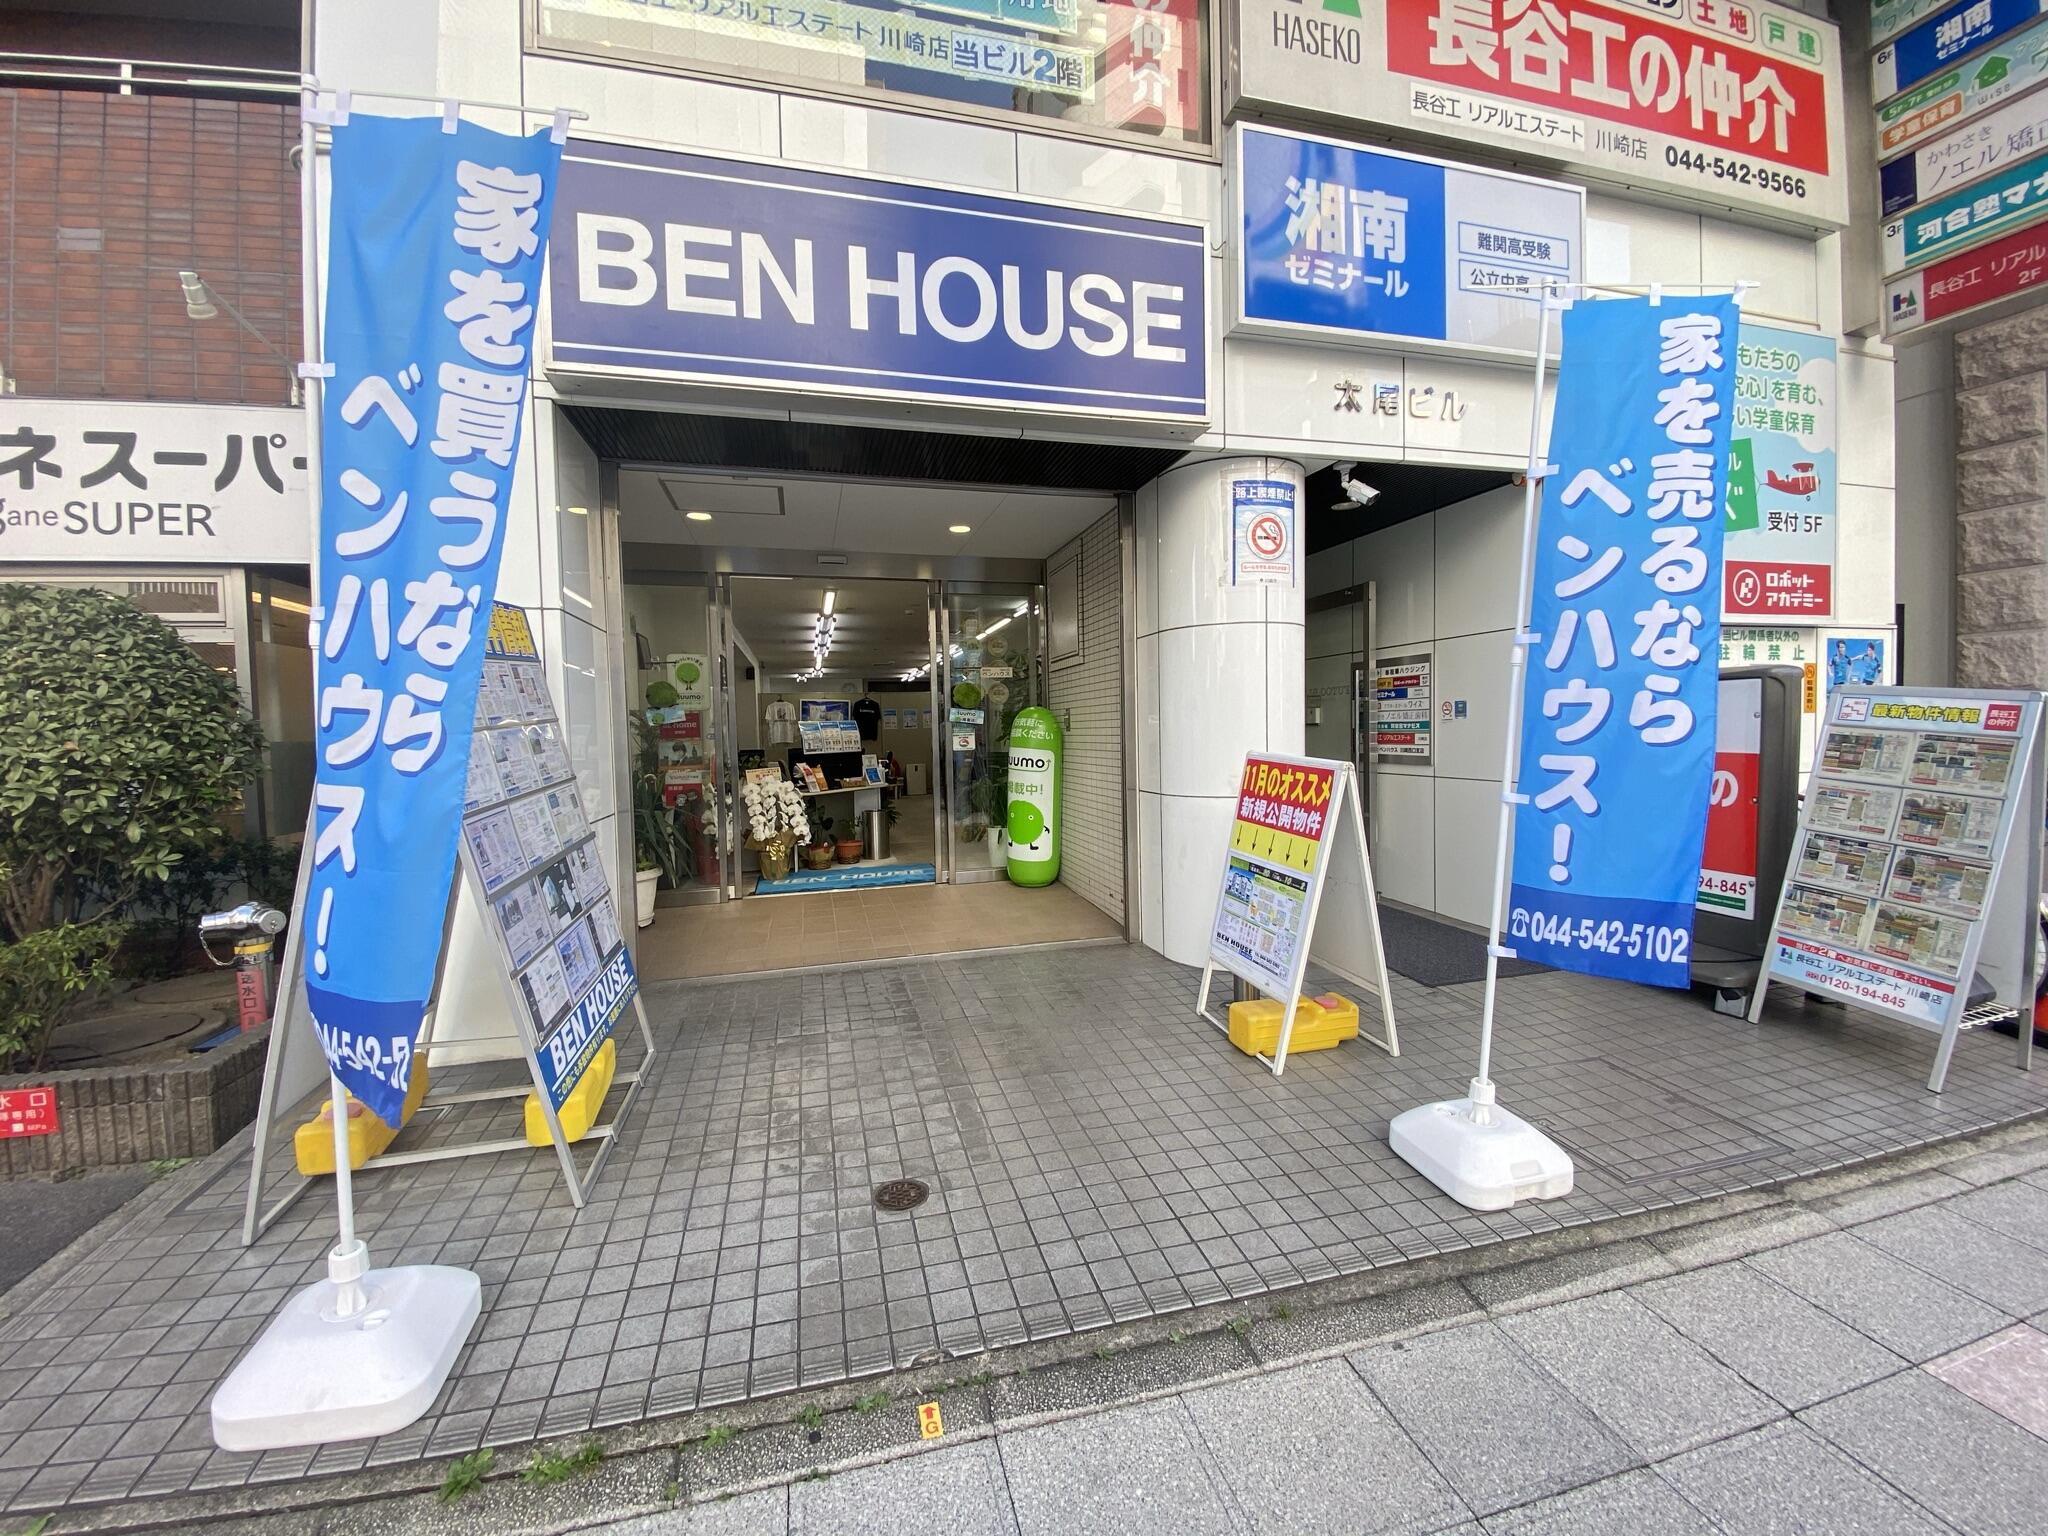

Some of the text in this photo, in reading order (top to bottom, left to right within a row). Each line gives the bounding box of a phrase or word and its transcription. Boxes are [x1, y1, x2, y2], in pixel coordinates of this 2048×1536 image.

[1273, 11, 1361, 64] HASEKO
[1697, 0, 1747, 34] 土地
[1767, 20, 1815, 57] 戸建
[1935, 3, 1992, 48] 湘南
[880, 26, 949, 60] 川崎店
[954, 39, 1081, 87] 当ビル2階
[1877, 51, 1893, 64] 6F
[1936, 24, 1994, 60] ゼミナール
[1428, 0, 1796, 153] 長谷工の仲介
[1412, 91, 1647, 160] 長谷工 リアルエステート 川崎店
[1927, 125, 1992, 165] かわさき
[1665, 145, 1806, 198] 044-542-9566
[1285, 175, 1409, 264] 湘南
[1887, 223, 1903, 238] 3F
[1477, 231, 1552, 261] 難関高受験
[576, 212, 1187, 364] BEN HOUSE
[1285, 254, 1409, 298] ゼミナール
[1929, 244, 2047, 300] 長谷工 リアル
[2018, 267, 2041, 285] 2F
[0, 426, 307, 494] ネスーパ
[381, 160, 543, 773] 家を買うなら
[1629, 312, 1724, 745] 家を売るなら
[1767, 512, 1823, 533] 受付 5F
[1765, 572, 1815, 589] ロボット
[1765, 591, 1824, 609] アカデミー
[1722, 629, 1800, 643] 当ビル関係者以外の
[1870, 703, 1981, 724] 最新物件情報
[1243, 763, 1333, 808] 11月のオススメ
[1240, 796, 1321, 837] 新規公開物件
[1531, 910, 1690, 964] 044-542-5102
[1796, 954, 1944, 1005] 長谷工 リアルエステート 川崎店
[1819, 974, 1906, 1008] 0120-194-845
[549, 1007, 587, 1078] BEN
[584, 953, 631, 1030] HOUSE
[925, 1421, 939, 1434] G
